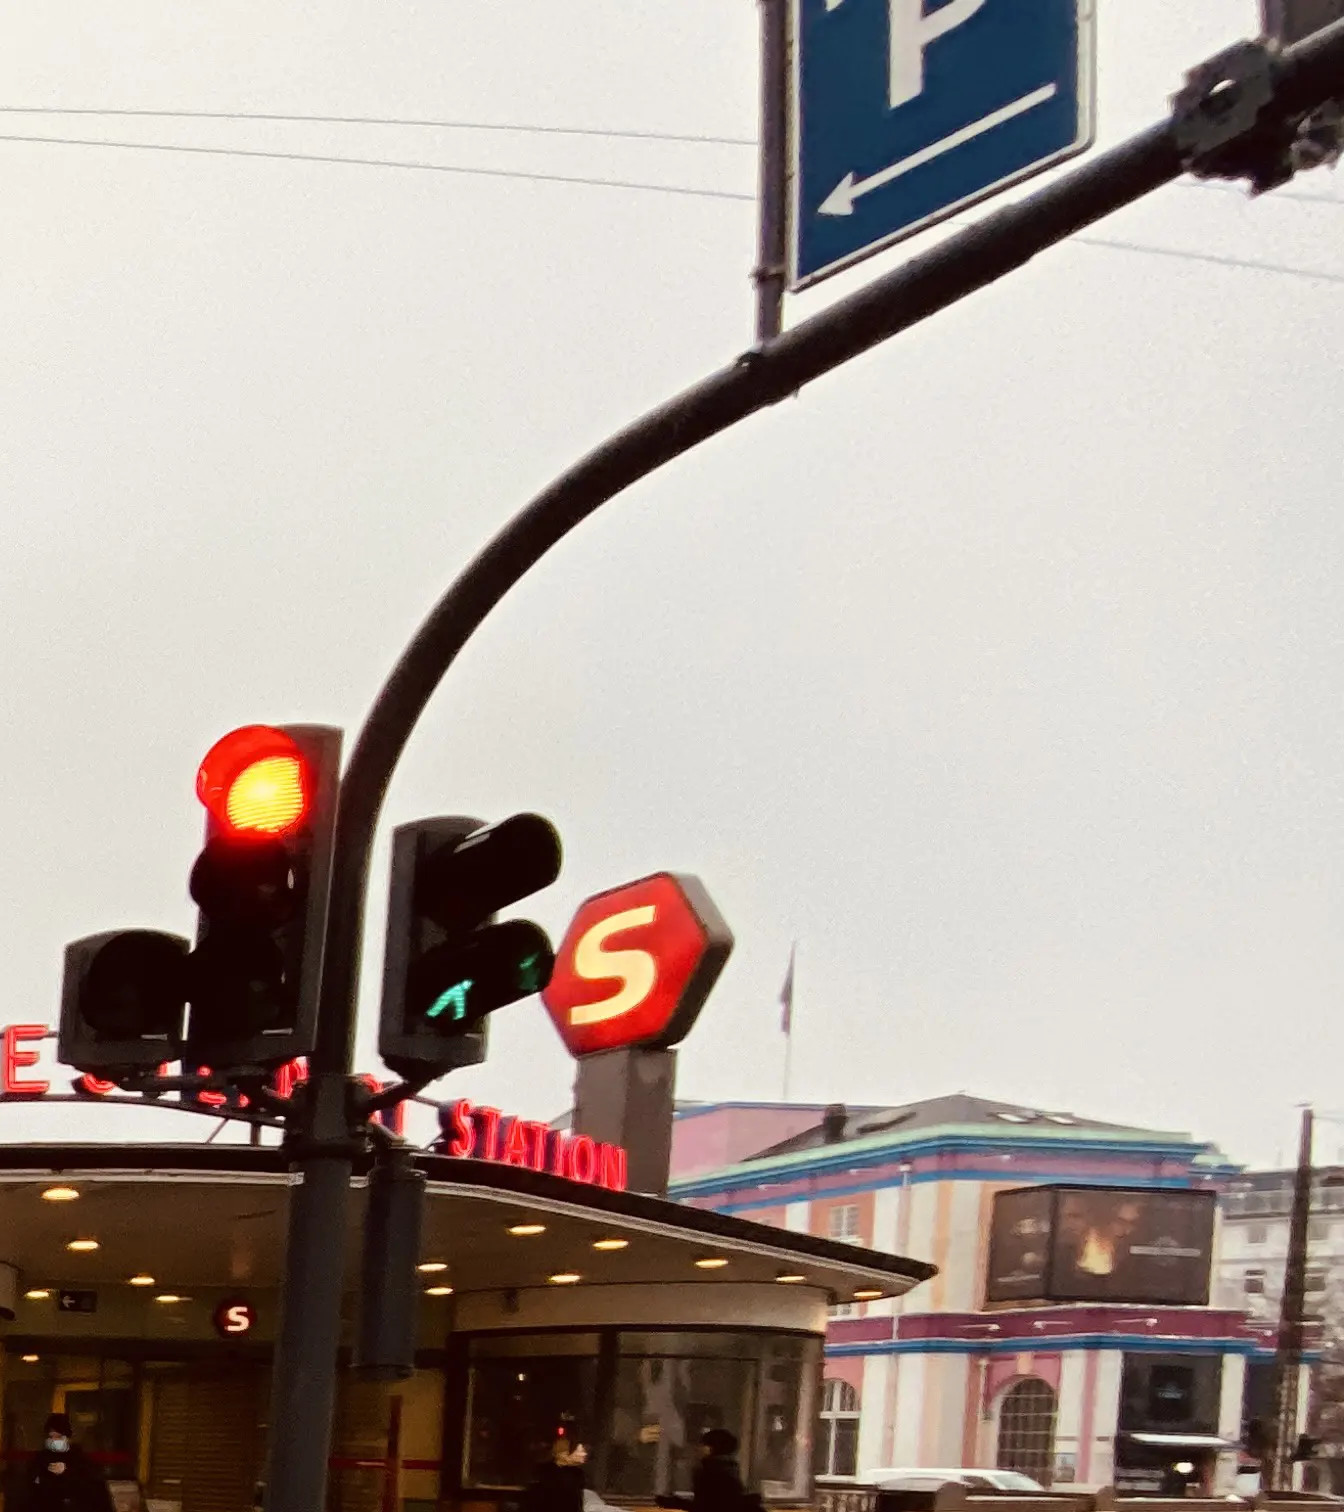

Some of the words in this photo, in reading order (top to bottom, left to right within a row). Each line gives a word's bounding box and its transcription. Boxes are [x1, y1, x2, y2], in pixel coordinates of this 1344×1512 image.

[571, 905, 656, 1026] S
[448, 1098, 628, 1191] STATION
[225, 1306, 250, 1332] S
